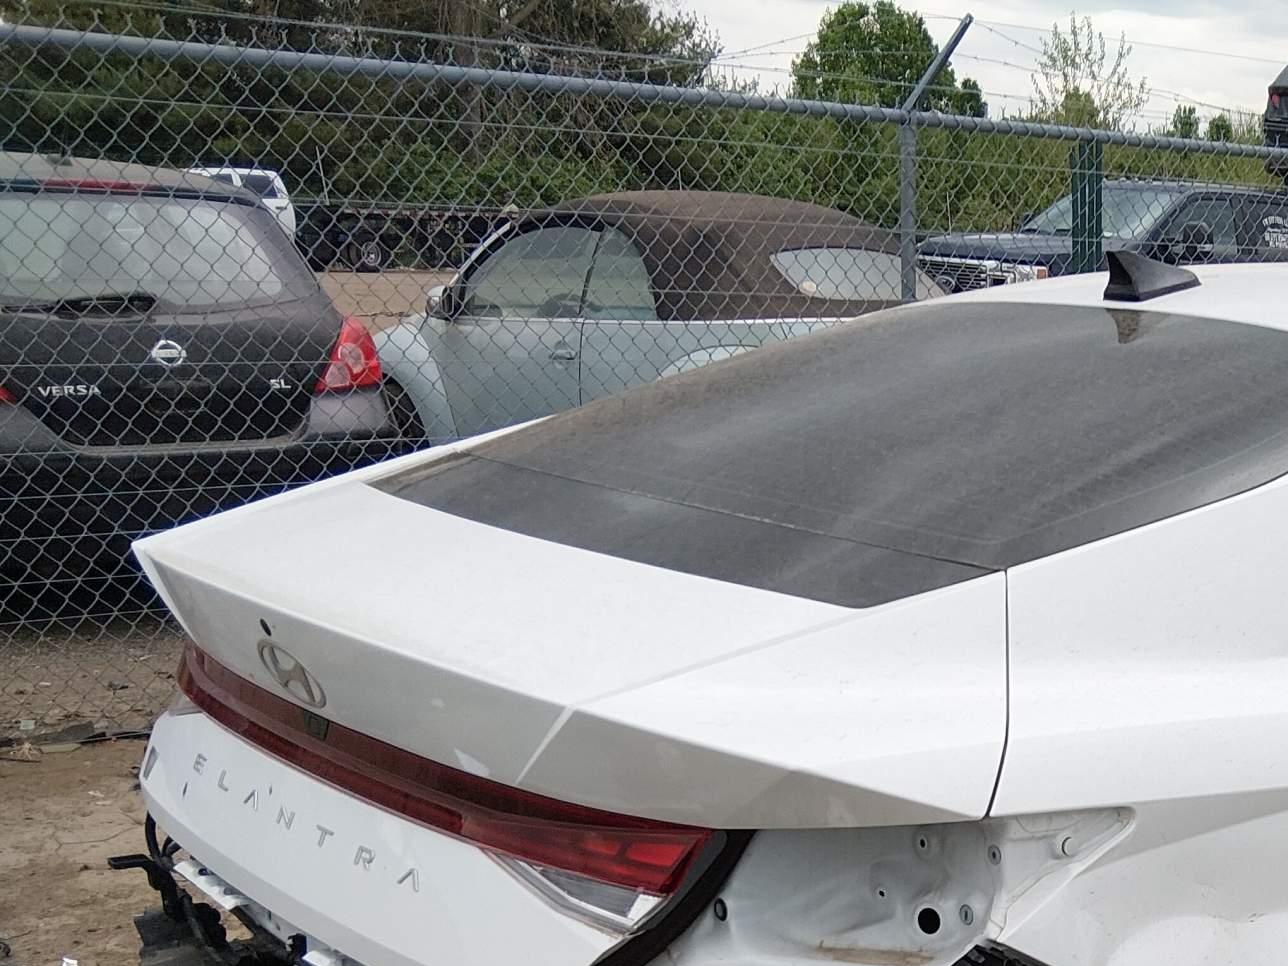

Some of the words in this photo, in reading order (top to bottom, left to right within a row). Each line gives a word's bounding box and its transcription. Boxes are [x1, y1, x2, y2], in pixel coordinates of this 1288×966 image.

[37, 384, 102, 397] VERSA
[270, 379, 291, 389] SL
[193, 752, 420, 893] ELANTRA
